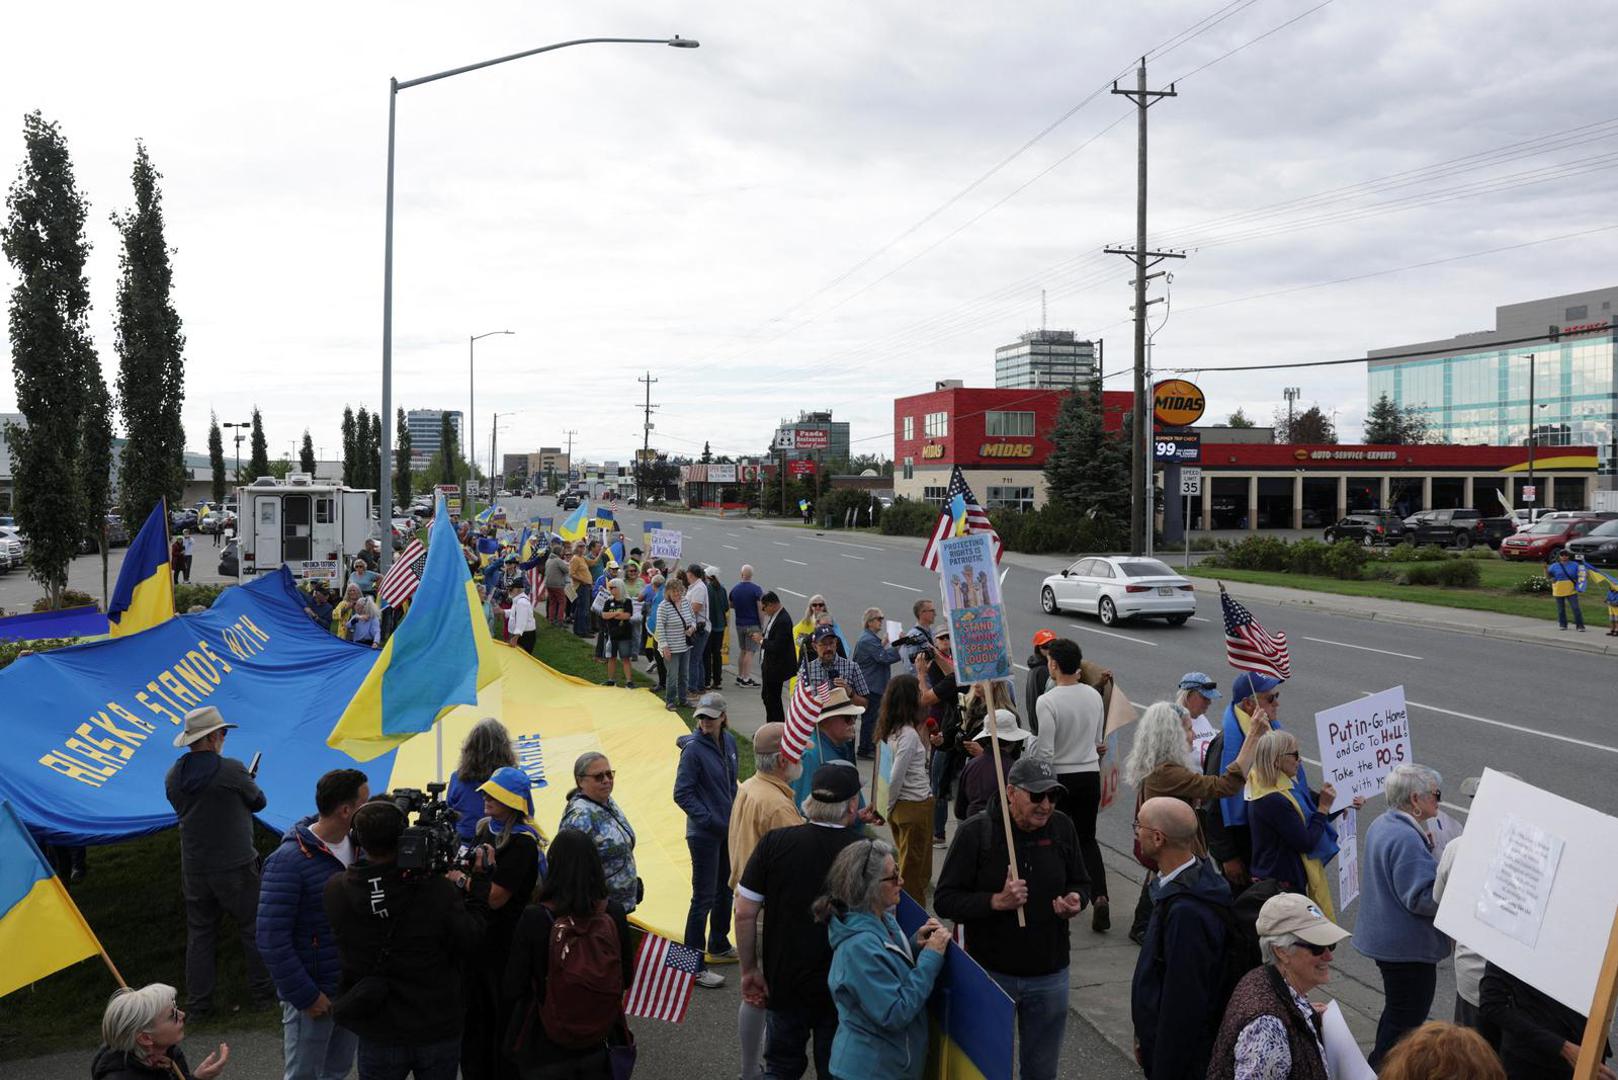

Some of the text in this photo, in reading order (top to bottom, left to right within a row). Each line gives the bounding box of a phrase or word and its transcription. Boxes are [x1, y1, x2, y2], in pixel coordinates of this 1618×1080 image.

[1153, 396, 1203, 411] MIDAS
[922, 444, 944, 459] MIDAS
[982, 443, 1034, 457] MIDAS
[1311, 451, 1331, 459] AUTO
[1334, 451, 1363, 460] SERVICE
[1367, 451, 1397, 460] EXPERTS
[1182, 482, 1198, 493] 35
[944, 538, 984, 551] PROTECTING
[949, 546, 982, 558] RIGHTS IS
[949, 554, 984, 566] PATRIOTIC
[962, 621, 994, 633] STAND
[966, 643, 995, 654] SPEAK
[965, 652, 998, 665] LOUDLY
[38, 614, 270, 788] ALASKA STANDS WITH
[1385, 709, 1406, 725] Home
[1336, 742, 1351, 759] and
[1352, 740, 1365, 752] Go
[1367, 734, 1379, 747] To
[1331, 768, 1354, 782] Take
[1357, 760, 1373, 771] the
[1351, 776, 1372, 794] with
